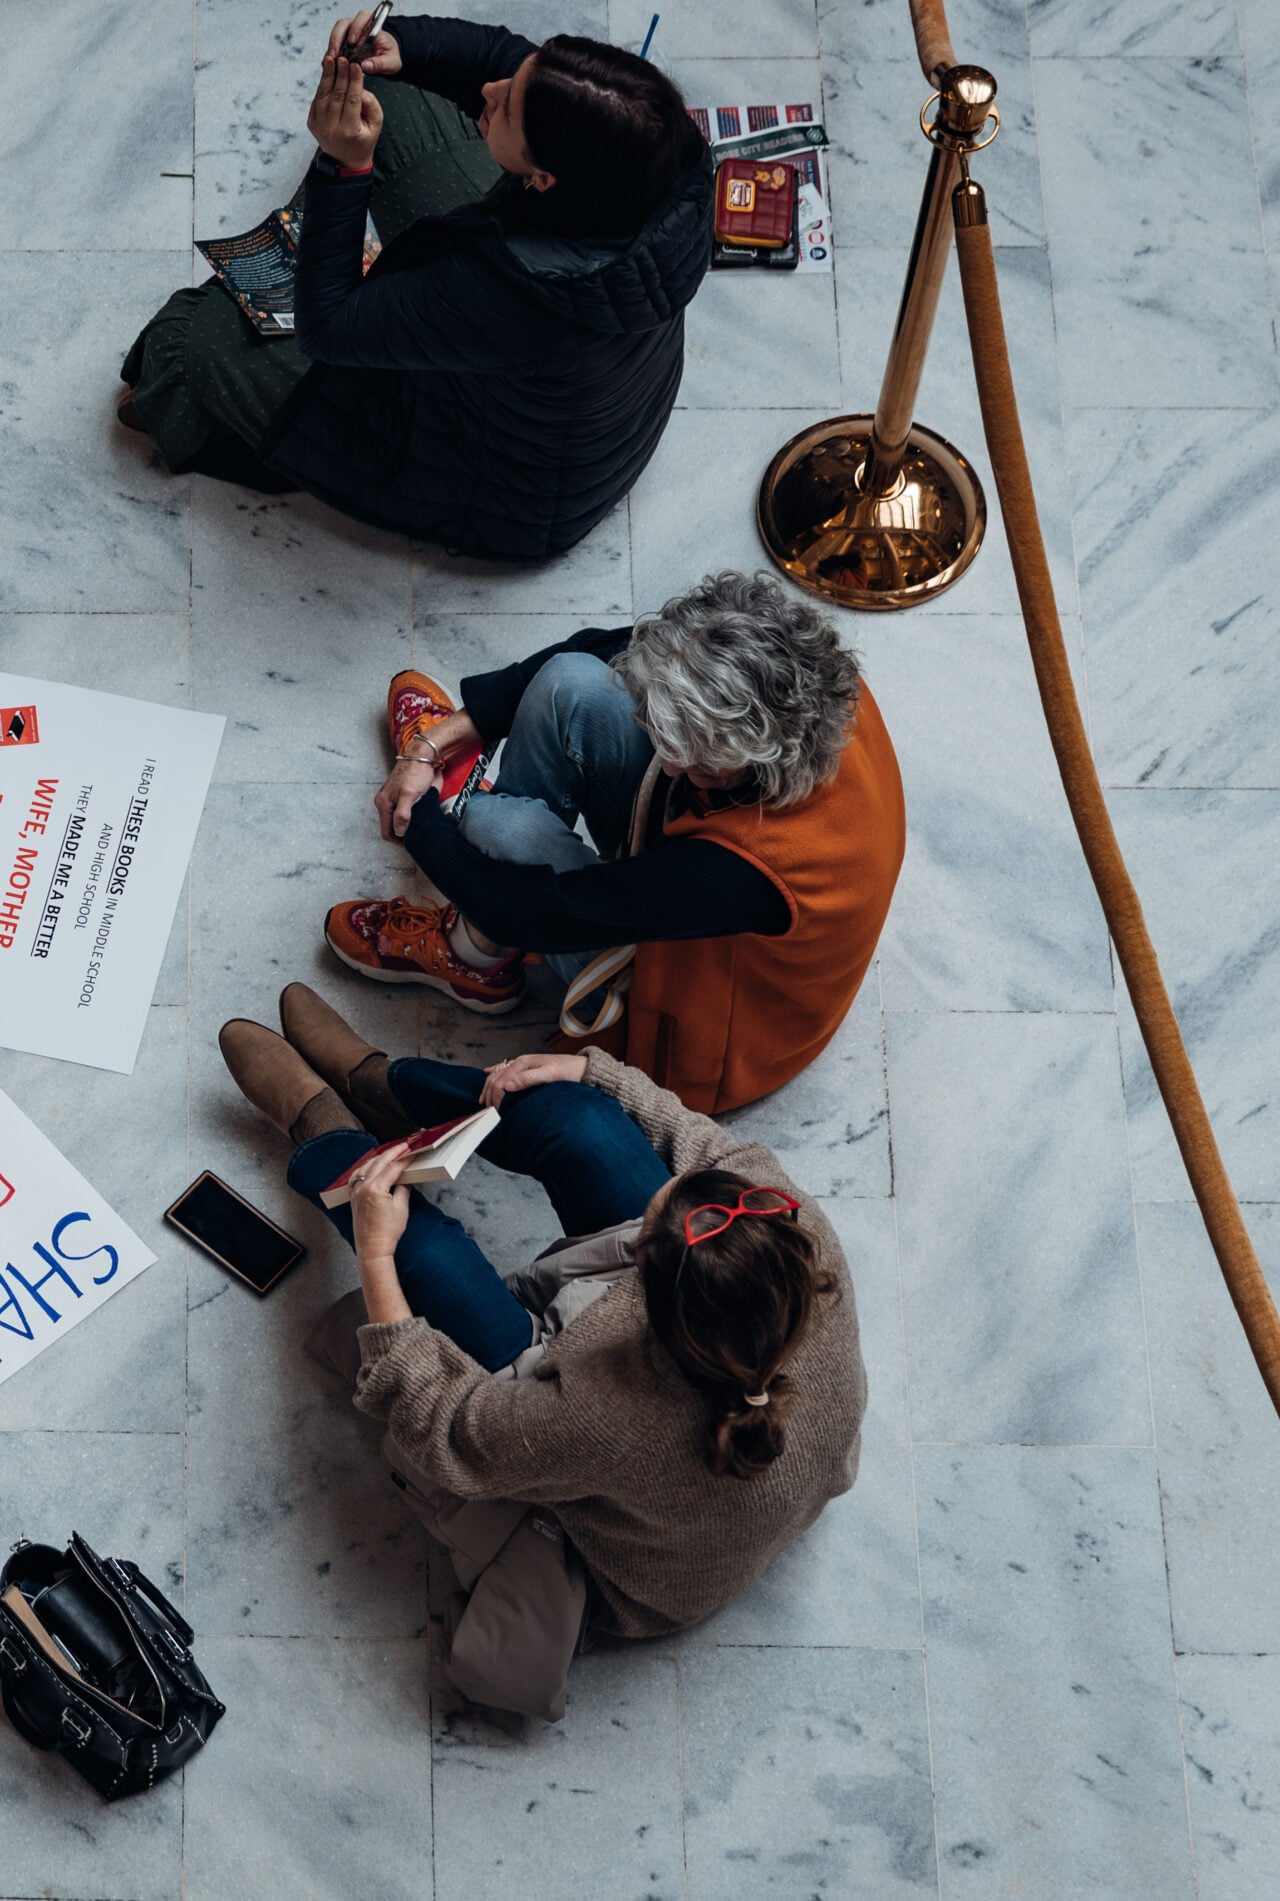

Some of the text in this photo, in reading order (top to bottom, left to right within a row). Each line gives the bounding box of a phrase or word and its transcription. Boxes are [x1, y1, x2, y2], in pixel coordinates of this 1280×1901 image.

[136, 764, 155, 796] READ
[18, 779, 58, 839] WIFE,
[123, 798, 149, 844] THESE
[32, 784, 93, 960] THEY MADE ME A BETTER
[73, 822, 113, 930] AND HIGH SCHOOL
[108, 844, 135, 896] BOOKS
[104, 897, 118, 912] IN
[90, 912, 114, 960] MIDDLE
[76, 960, 101, 1009] SCHOOL
